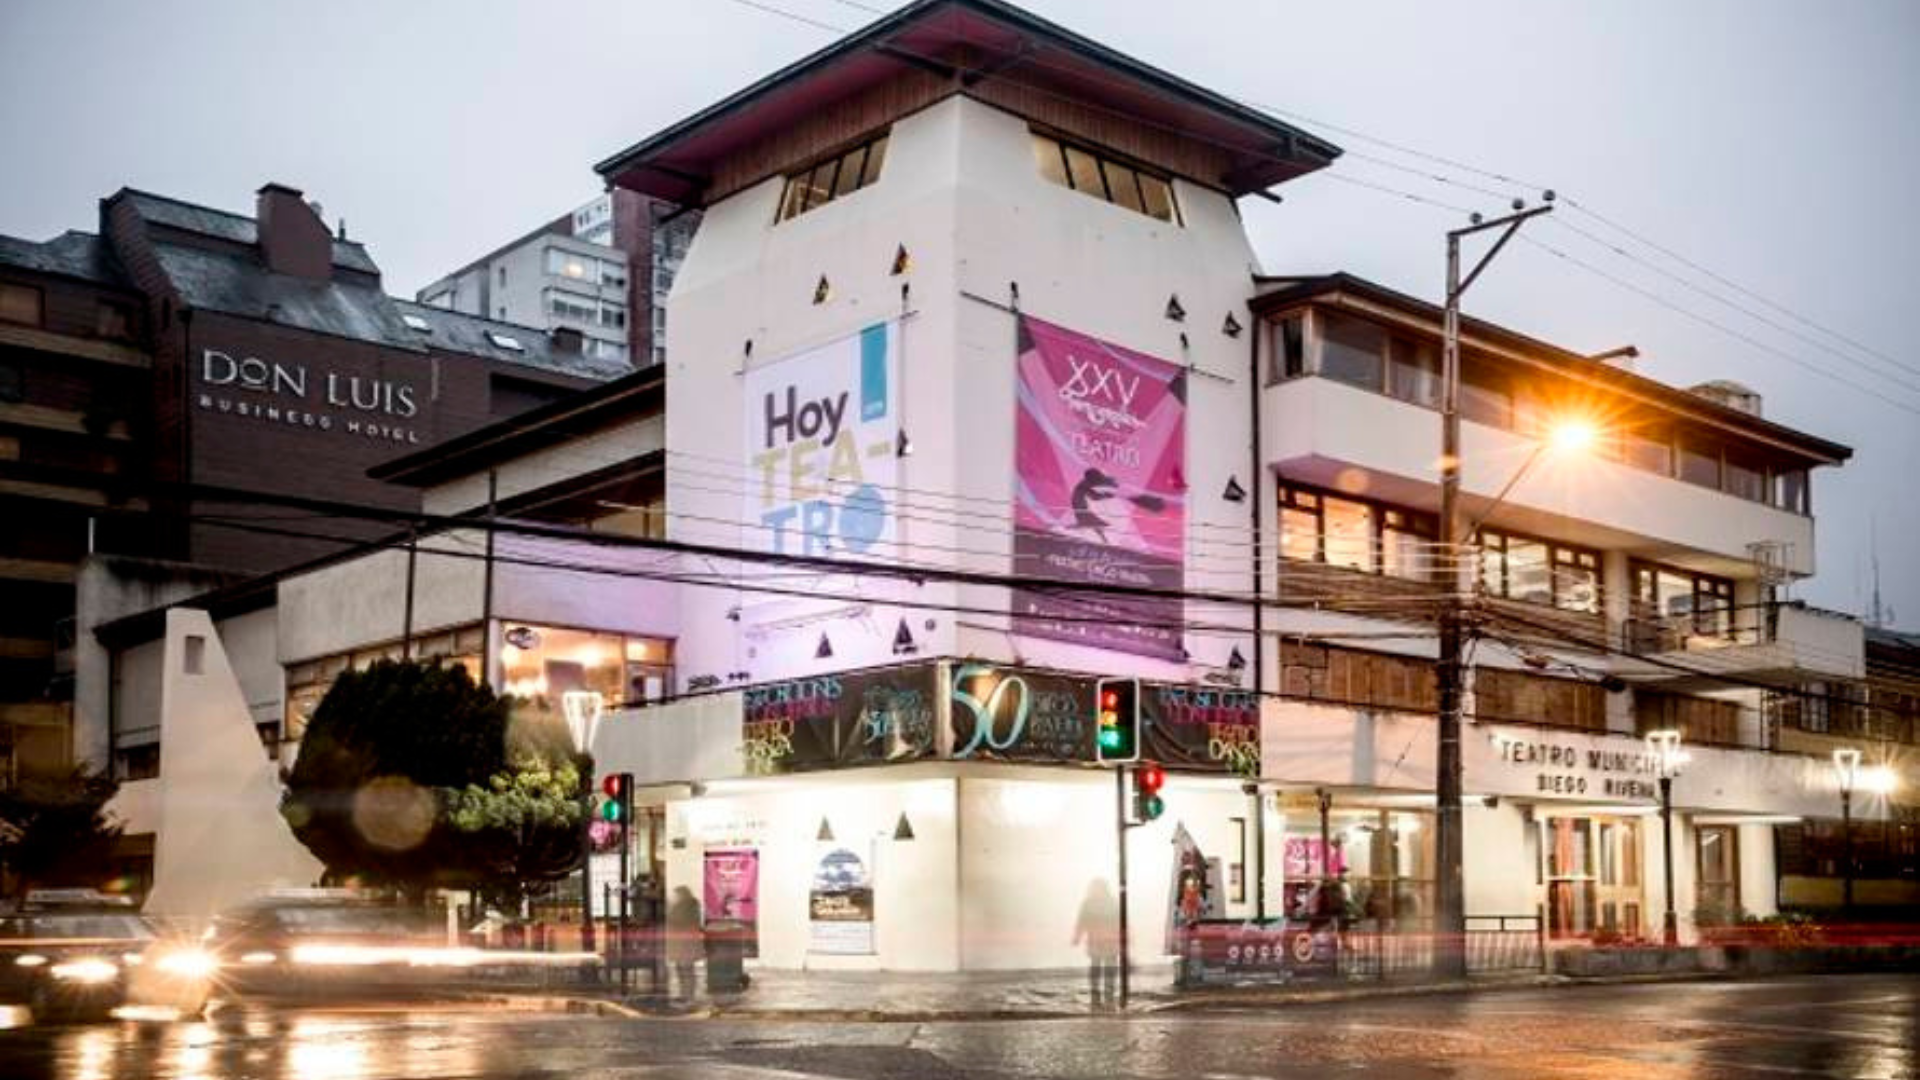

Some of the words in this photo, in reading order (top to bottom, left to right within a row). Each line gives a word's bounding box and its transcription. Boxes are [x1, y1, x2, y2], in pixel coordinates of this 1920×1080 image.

[204, 350, 305, 397] DON
[328, 373, 417, 418] LUIS
[200, 395, 332, 429] BUSINESS
[348, 421, 419, 443] HOTEL
[765, 385, 848, 448] Hoy
[951, 663, 1028, 759] 50
[1502, 741, 1576, 768] TEATRO
[1588, 749, 1680, 776] MUNICI
[1537, 773, 1588, 795] DIEGO
